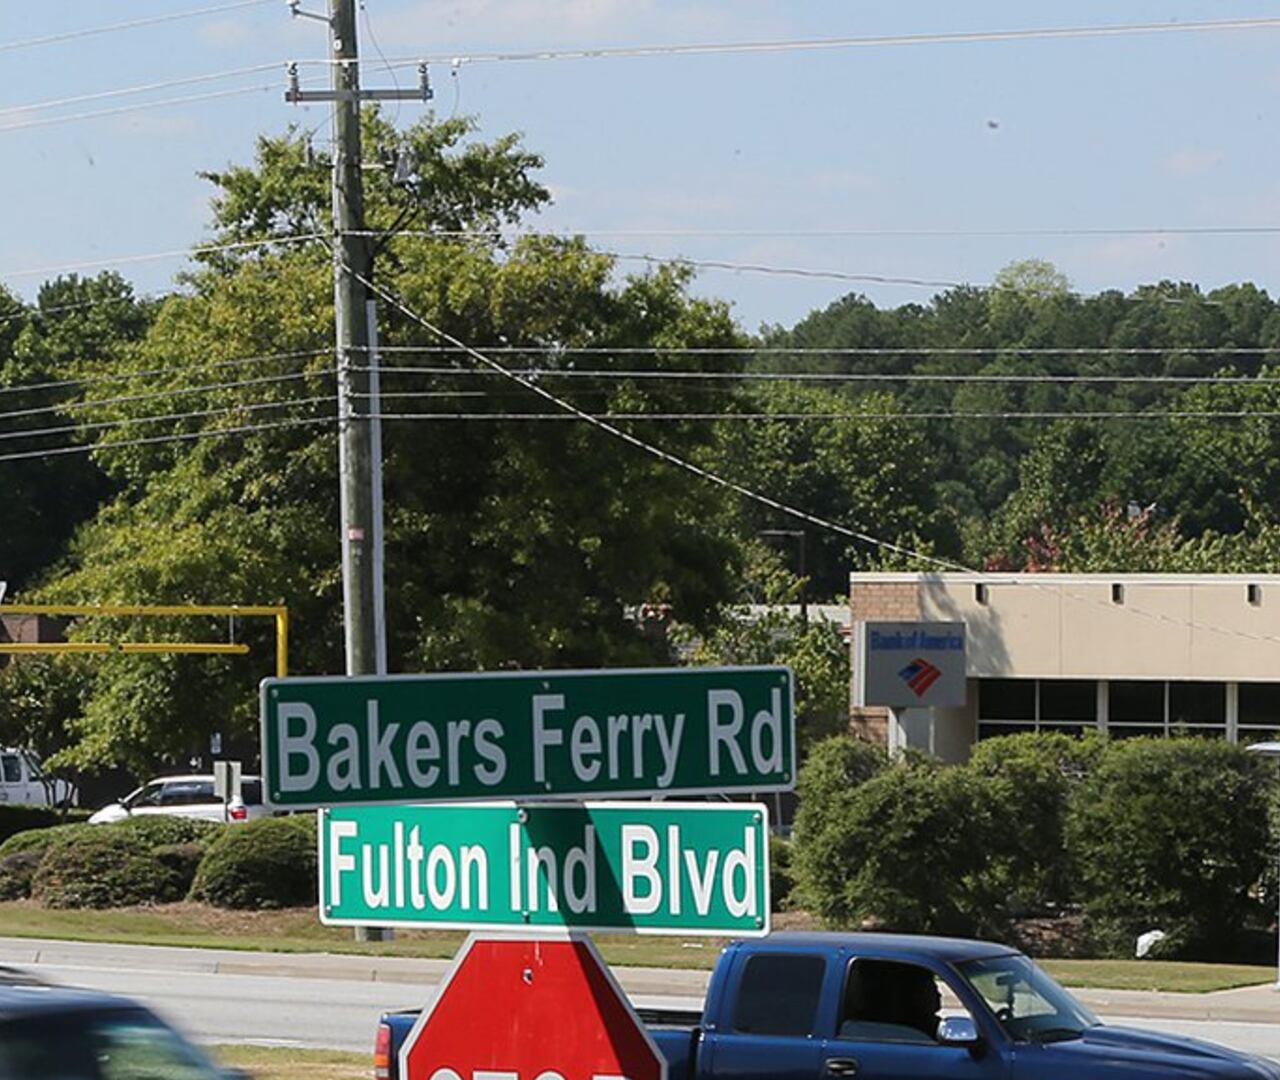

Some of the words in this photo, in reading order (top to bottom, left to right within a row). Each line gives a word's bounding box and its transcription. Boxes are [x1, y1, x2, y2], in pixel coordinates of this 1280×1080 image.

[276, 699, 508, 793] Bakers
[531, 693, 686, 789] Ferry
[707, 686, 784, 777] Rd
[328, 819, 488, 910] Fulton
[509, 822, 597, 914] Ind
[619, 823, 756, 918] Blvd
